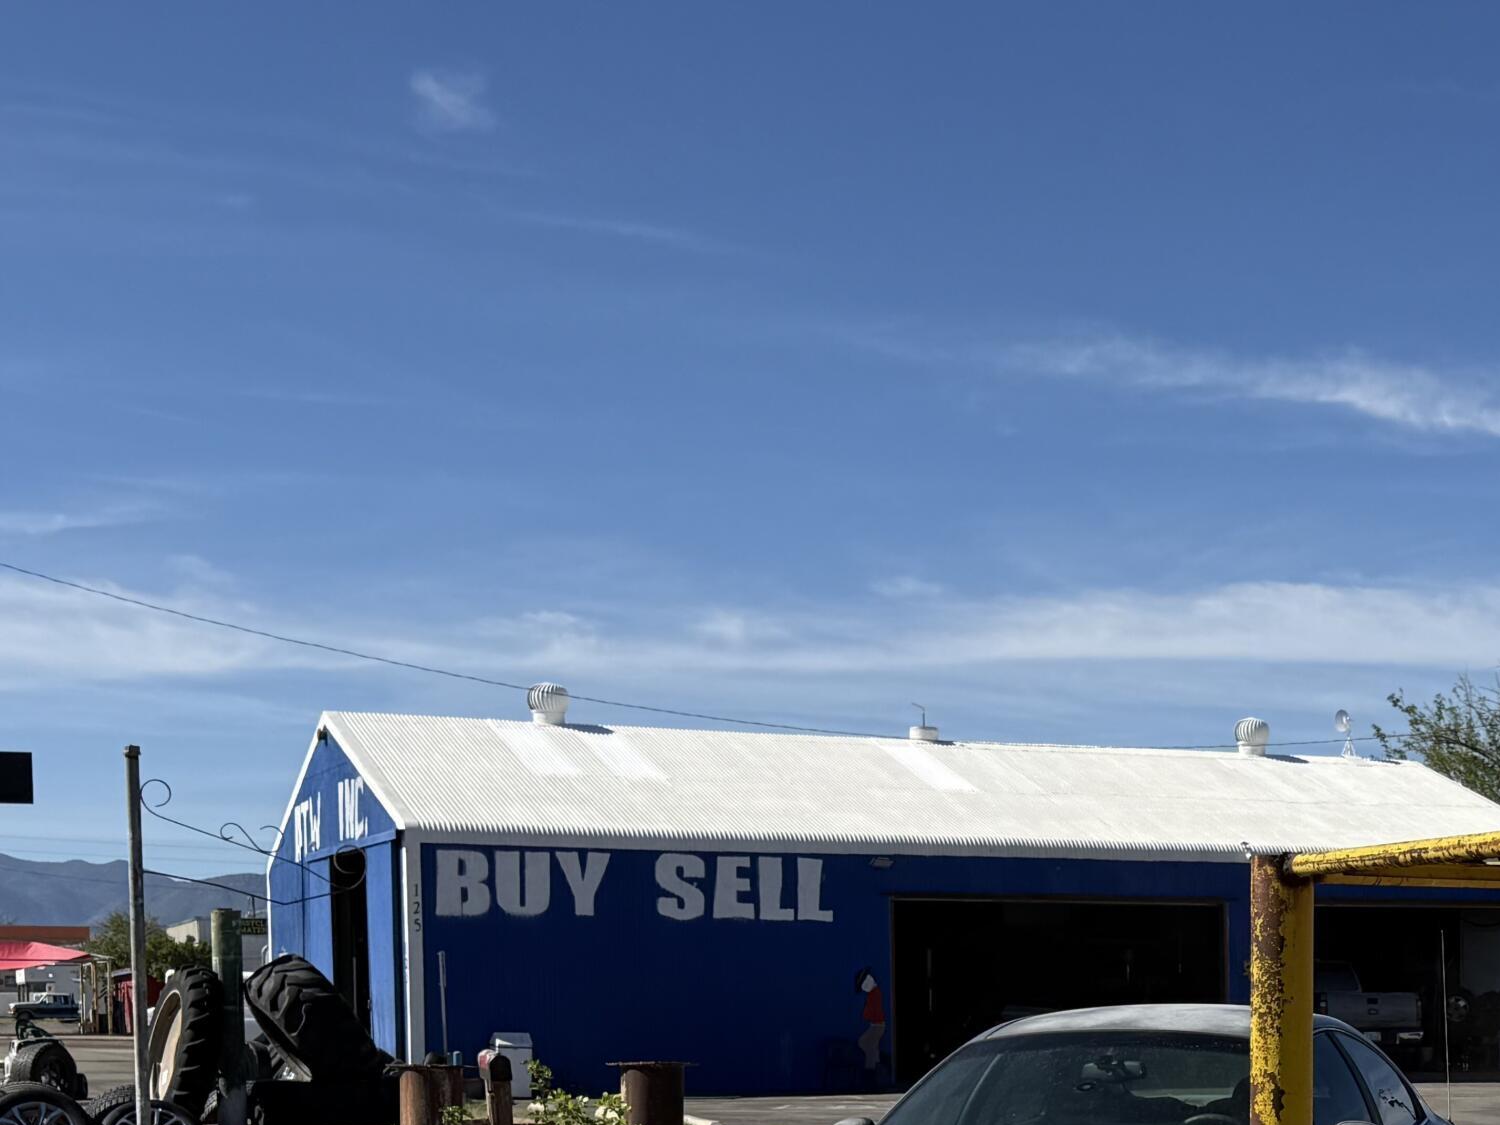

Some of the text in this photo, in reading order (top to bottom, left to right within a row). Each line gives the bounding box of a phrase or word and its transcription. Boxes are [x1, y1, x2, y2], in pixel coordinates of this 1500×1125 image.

[337, 775, 369, 841] INC.
[412, 883, 422, 933] 125
[435, 849, 834, 923] BUY SELL
